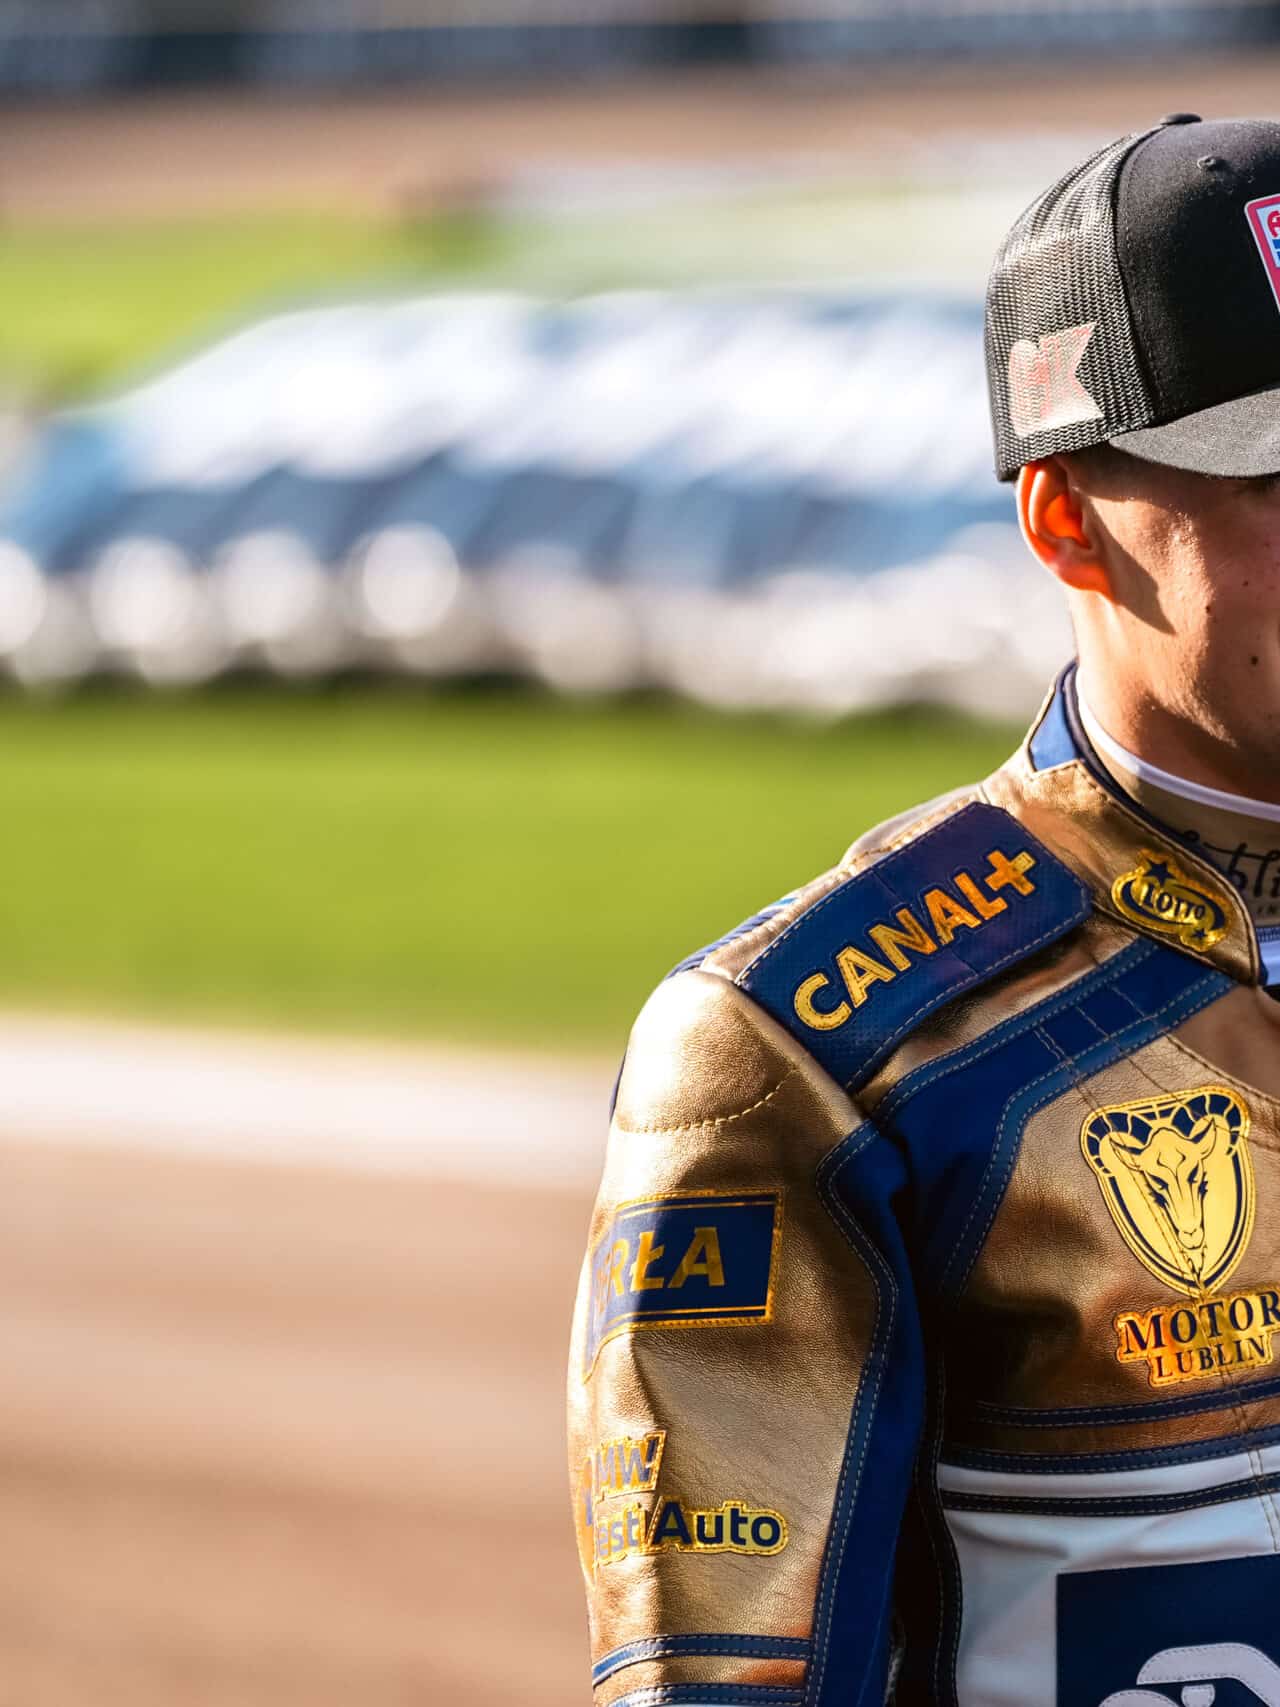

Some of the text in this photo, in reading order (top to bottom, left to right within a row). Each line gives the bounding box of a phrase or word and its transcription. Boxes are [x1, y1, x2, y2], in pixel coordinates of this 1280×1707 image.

[793, 849, 1036, 1031] CANAL+
[599, 1226, 725, 1300] RŁA
[1156, 1335, 1269, 1378] LUBLIN
[596, 1437, 659, 1488] MW
[588, 1500, 782, 1556] est Auto
